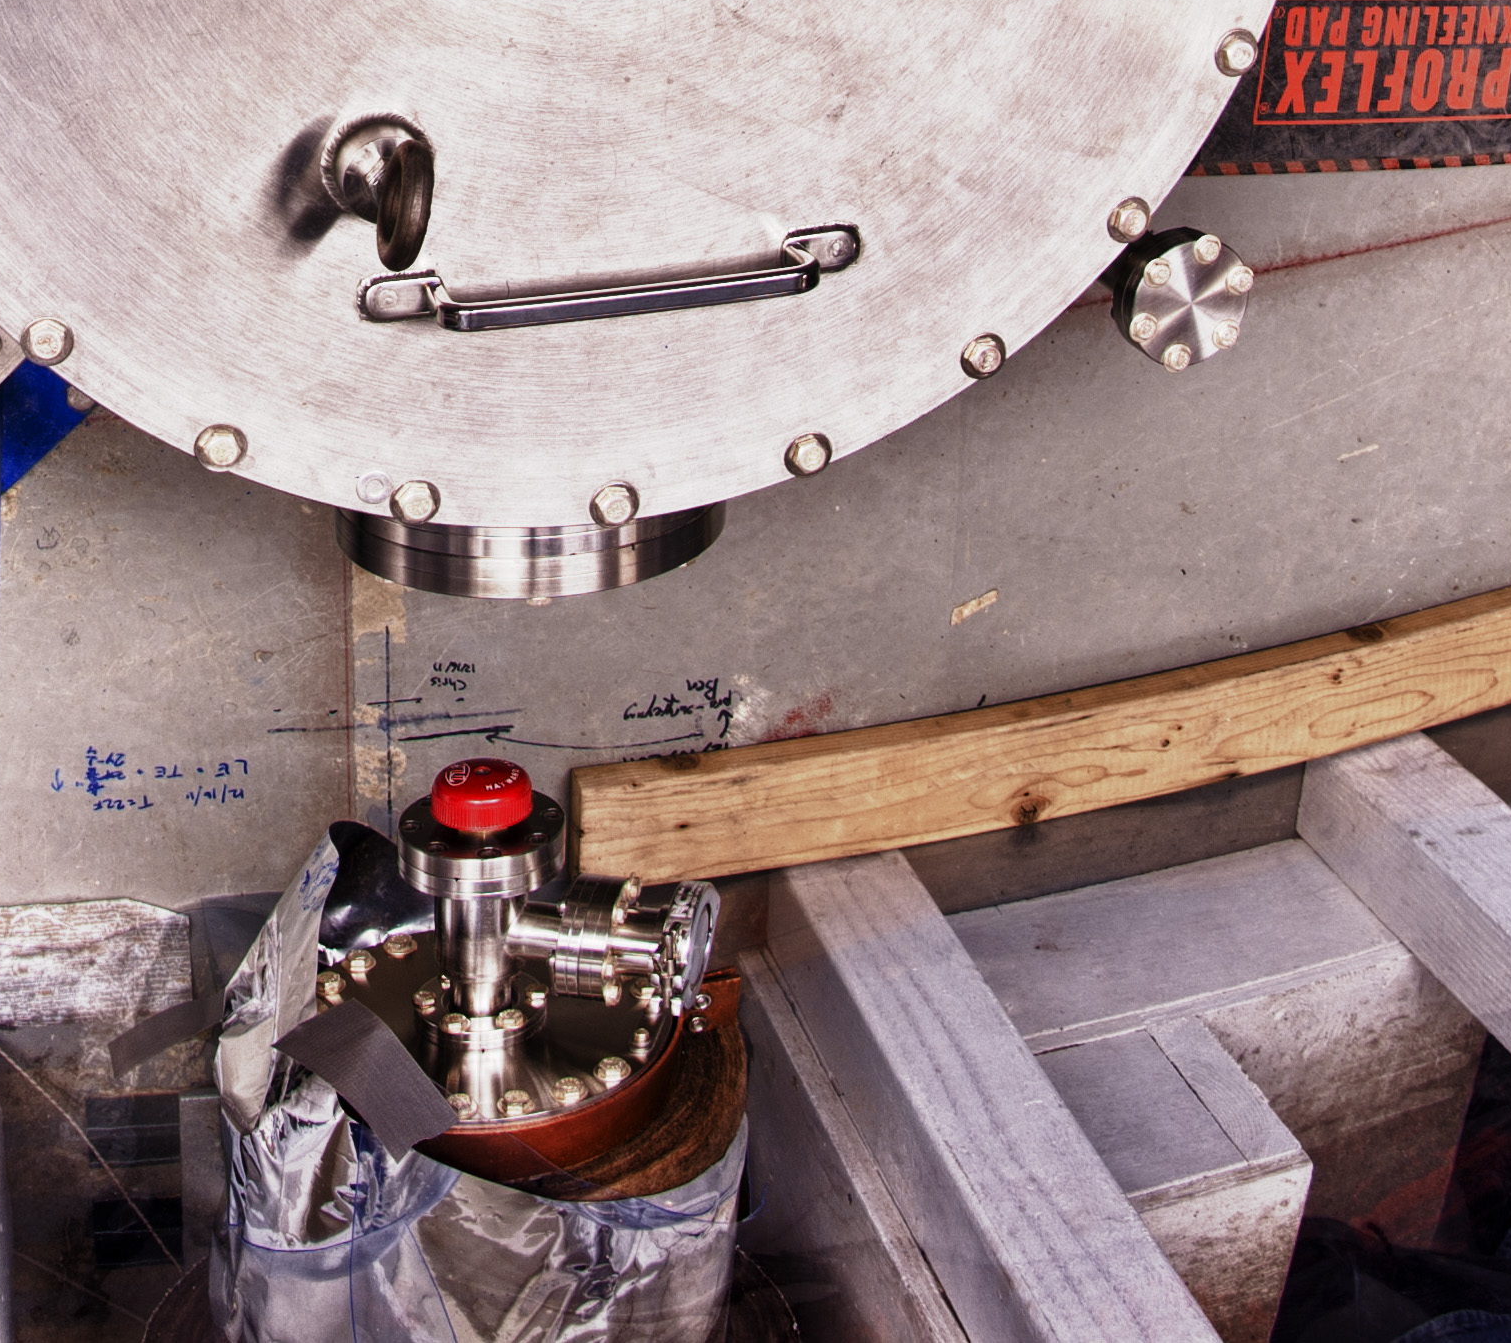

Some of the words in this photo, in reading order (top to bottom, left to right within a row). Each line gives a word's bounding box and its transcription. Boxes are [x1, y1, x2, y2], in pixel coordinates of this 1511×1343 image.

[1283, 6, 1351, 48] PAD
[429, 676, 467, 691] Chris
[686, 678, 718, 699] Ben
